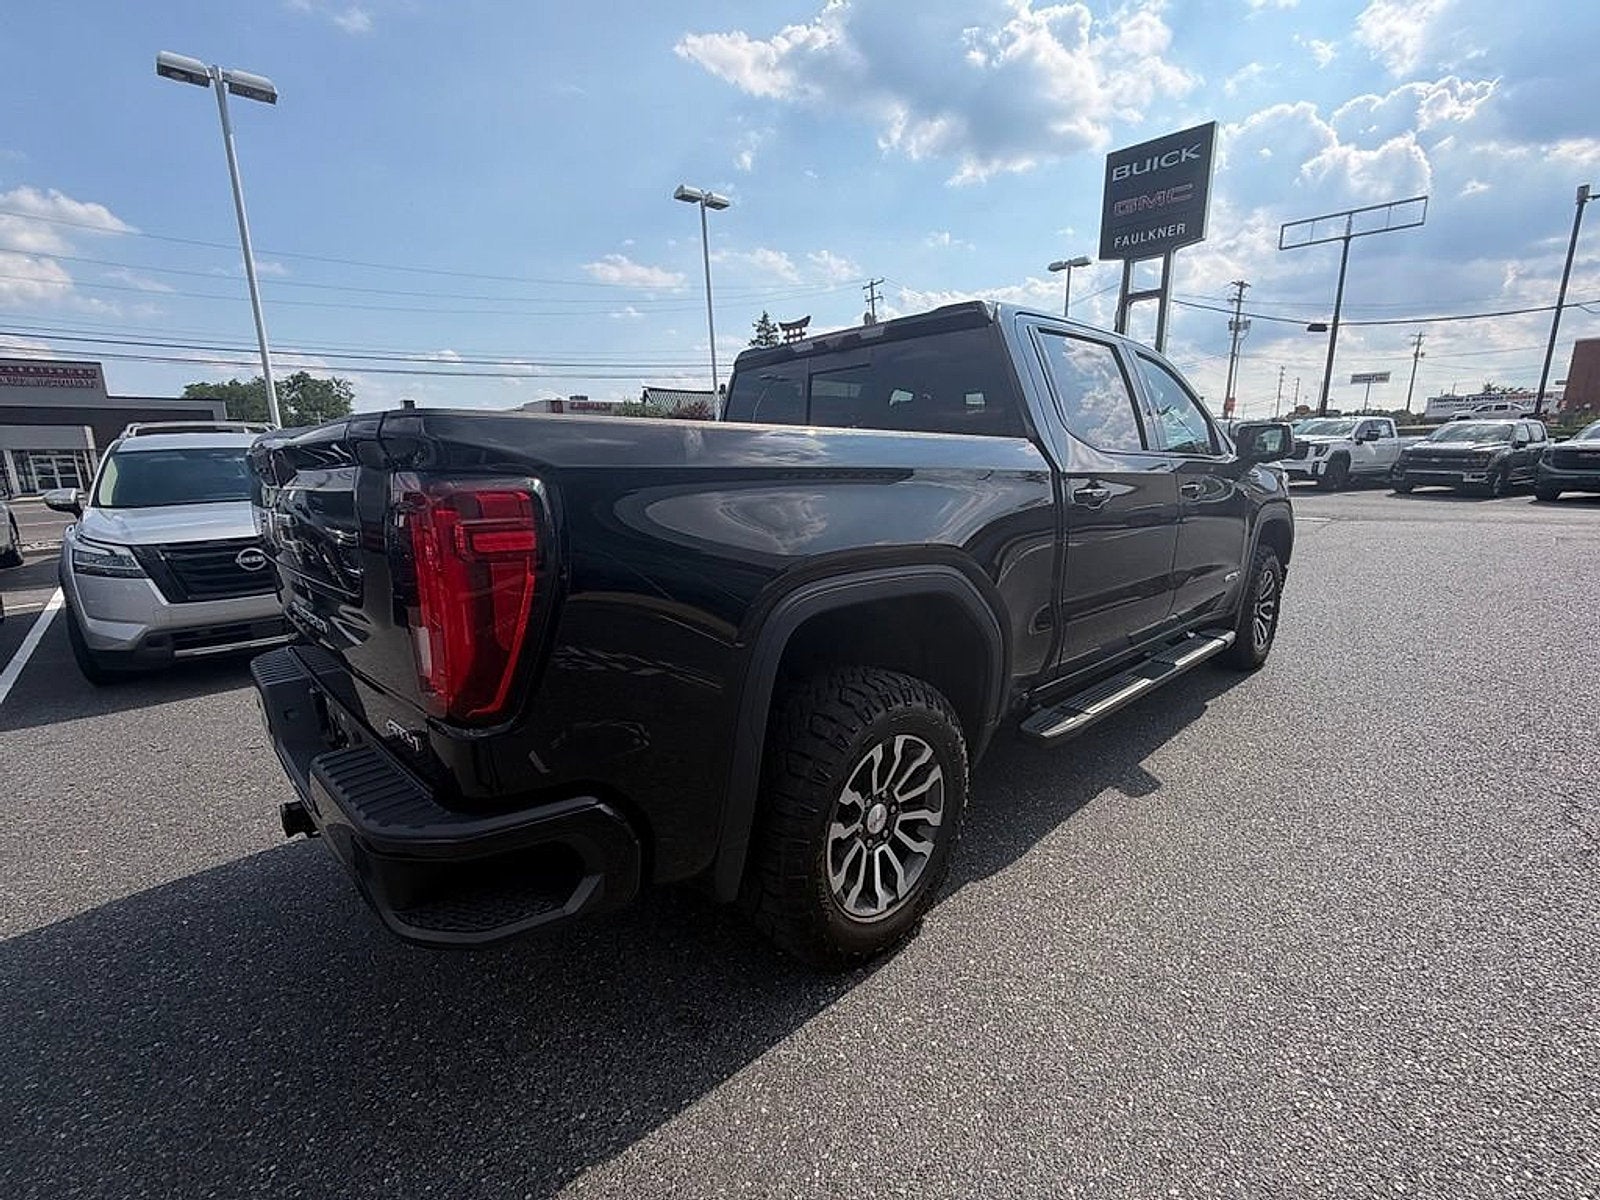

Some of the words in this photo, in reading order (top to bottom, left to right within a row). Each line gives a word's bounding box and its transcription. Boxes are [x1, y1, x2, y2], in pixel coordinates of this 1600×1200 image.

[1112, 143, 1201, 182] BUICK
[1113, 183, 1193, 216] GMC
[1113, 223, 1186, 249] FAULKNER
